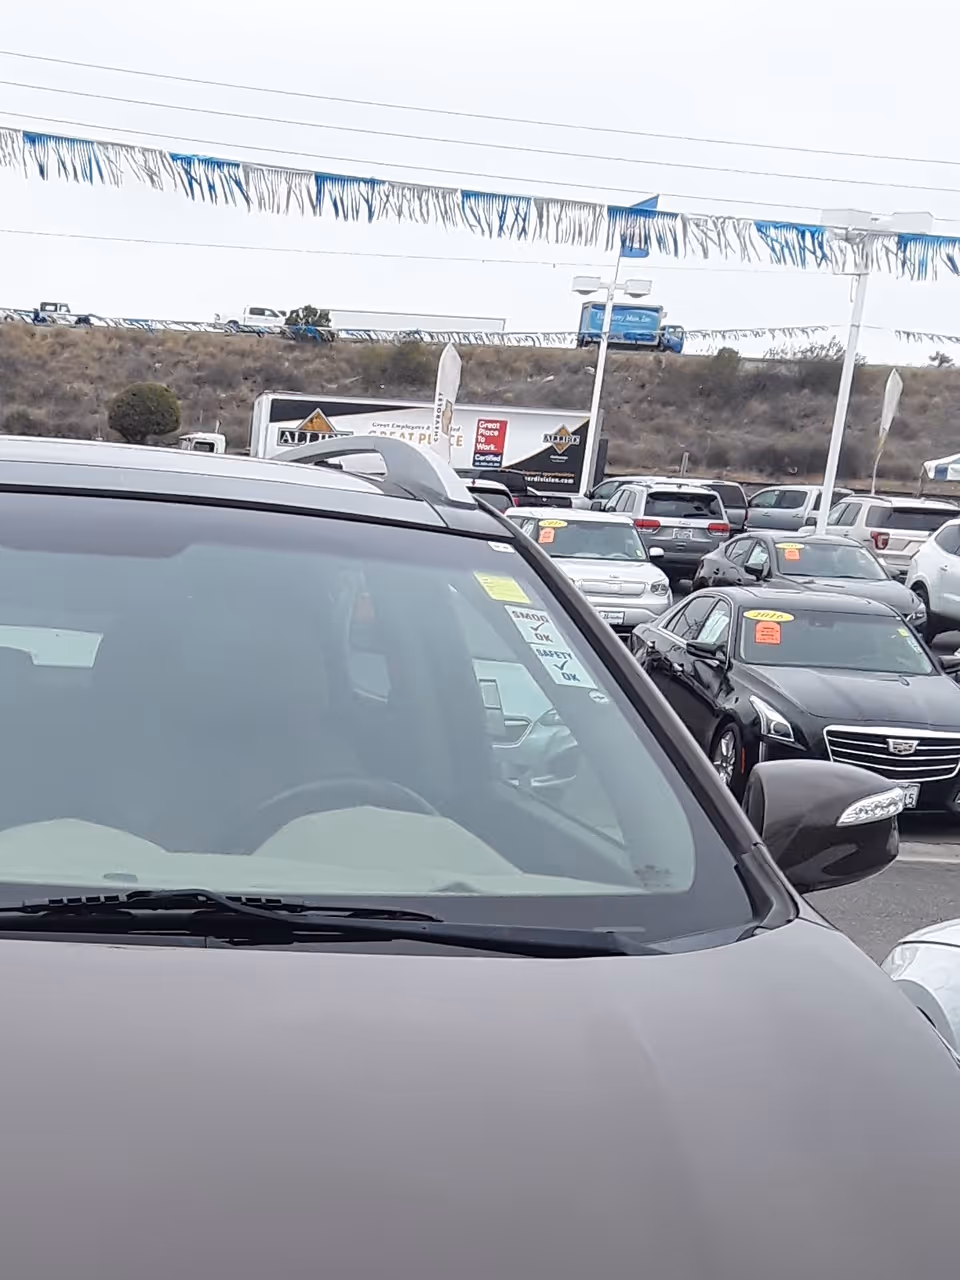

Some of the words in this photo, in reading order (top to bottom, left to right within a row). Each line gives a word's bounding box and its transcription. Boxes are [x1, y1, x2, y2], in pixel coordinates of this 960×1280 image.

[434, 392, 444, 442] CHEVROLET
[478, 421, 500, 429] Great
[478, 428, 499, 436] Place
[534, 633, 553, 643] OK
[536, 648, 574, 660] SAFETY
[561, 672, 581, 682] OK
